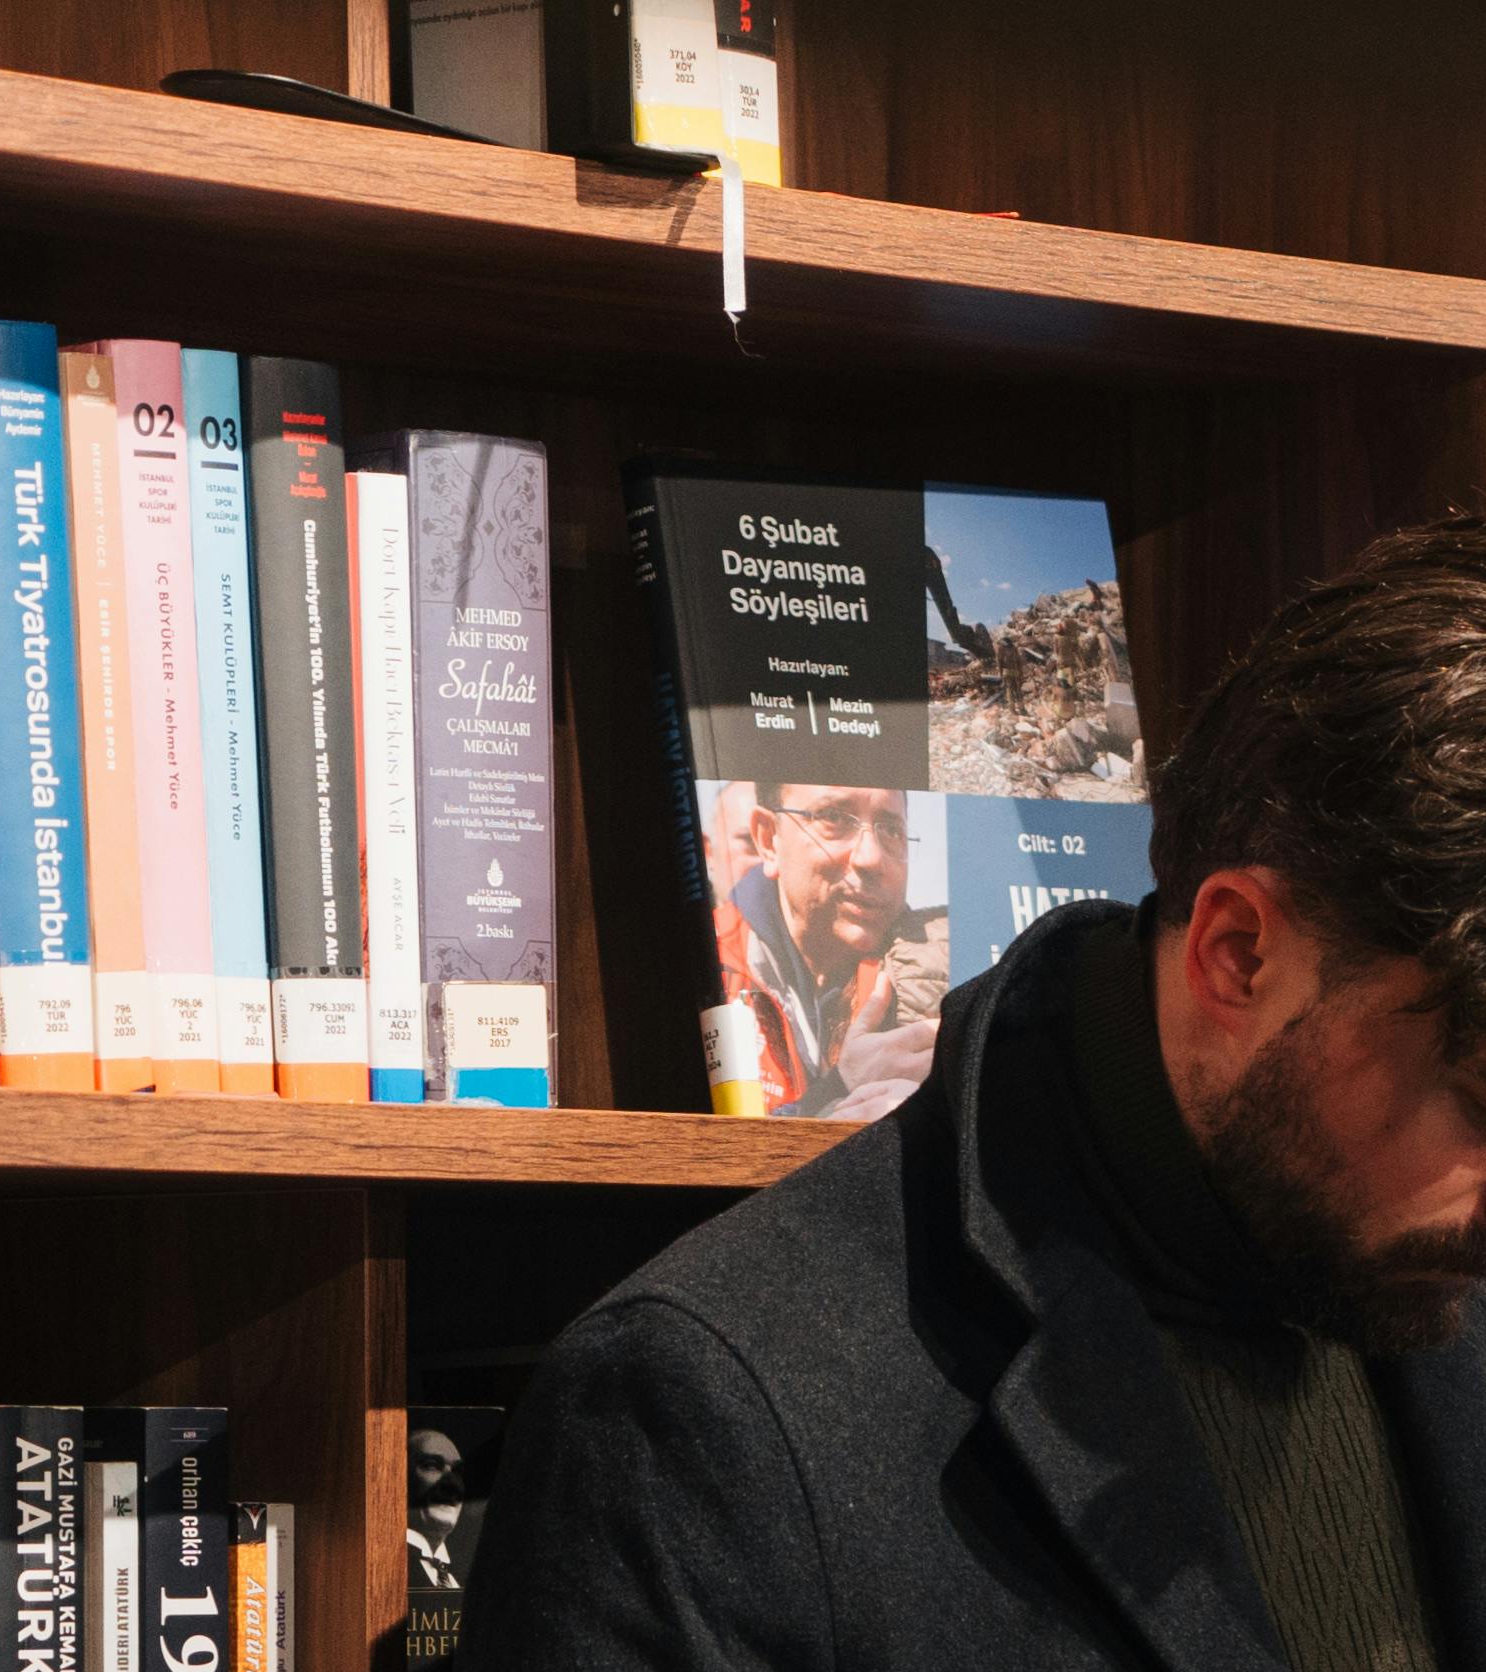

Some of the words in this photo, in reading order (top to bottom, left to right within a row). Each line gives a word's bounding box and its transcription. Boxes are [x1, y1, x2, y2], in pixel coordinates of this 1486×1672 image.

[669, 50, 697, 63] 371.04
[675, 72, 695, 84] 2022
[133, 403, 176, 439] 02
[200, 417, 238, 452] 03
[13, 461, 45, 546] Türk
[739, 515, 755, 539] 6
[760, 516, 840, 548] Şubat
[155, 563, 171, 585] ÜÇ
[303, 520, 323, 644] Cumhuriyet'in
[721, 550, 866, 590] Dayanışma
[220, 573, 234, 616] SEMT
[729, 587, 869, 625] Söyleşileri
[456, 607, 521, 627] MEHMED
[157, 592, 176, 681] BÜYÜKLER
[447, 627, 482, 648] ÂKİF
[487, 633, 529, 652] ERSOY
[20, 554, 60, 808] Tiyatrosunda
[222, 623, 240, 713] KULÜPLERİ
[308, 648, 328, 685] 100.
[768, 656, 850, 677] Hazırlayan:
[438, 659, 537, 716] Safahât
[750, 692, 794, 710] Murat
[312, 689, 329, 749] Yılında
[755, 712, 795, 731] Erdin
[829, 697, 874, 714] Mezin
[164, 699, 180, 766] Mehmet
[446, 718, 530, 737] ÇALIŞMALARI
[828, 717, 881, 737] Dedeyi
[225, 731, 242, 796] Mehmet
[315, 753, 331, 793] Türk
[167, 775, 182, 810] Yüce
[227, 805, 243, 840] Yüce
[317, 797, 335, 895] Futbolunun
[1018, 833, 1056, 854] Cilt:
[1062, 835, 1086, 855] 02
[393, 878, 402, 910] AYŞE
[322, 900, 336, 931] 100
[394, 916, 404, 951] ACAR
[38, 1000, 71, 1009] 792.09
[47, 1011, 66, 1020] TUR
[477, 1017, 519, 1026] 811.4109
[47, 1023, 69, 1032] 2022
[489, 1039, 511, 1048] 2017
[491, 1028, 508, 1036] ERS
[57, 1438, 77, 1486] GAZİ
[180, 1456, 201, 1509] orhan
[57, 1494, 77, 1600] MUSTAFA
[179, 1515, 203, 1566] çekiç
[116, 1567, 129, 1630] ATATÜRK
